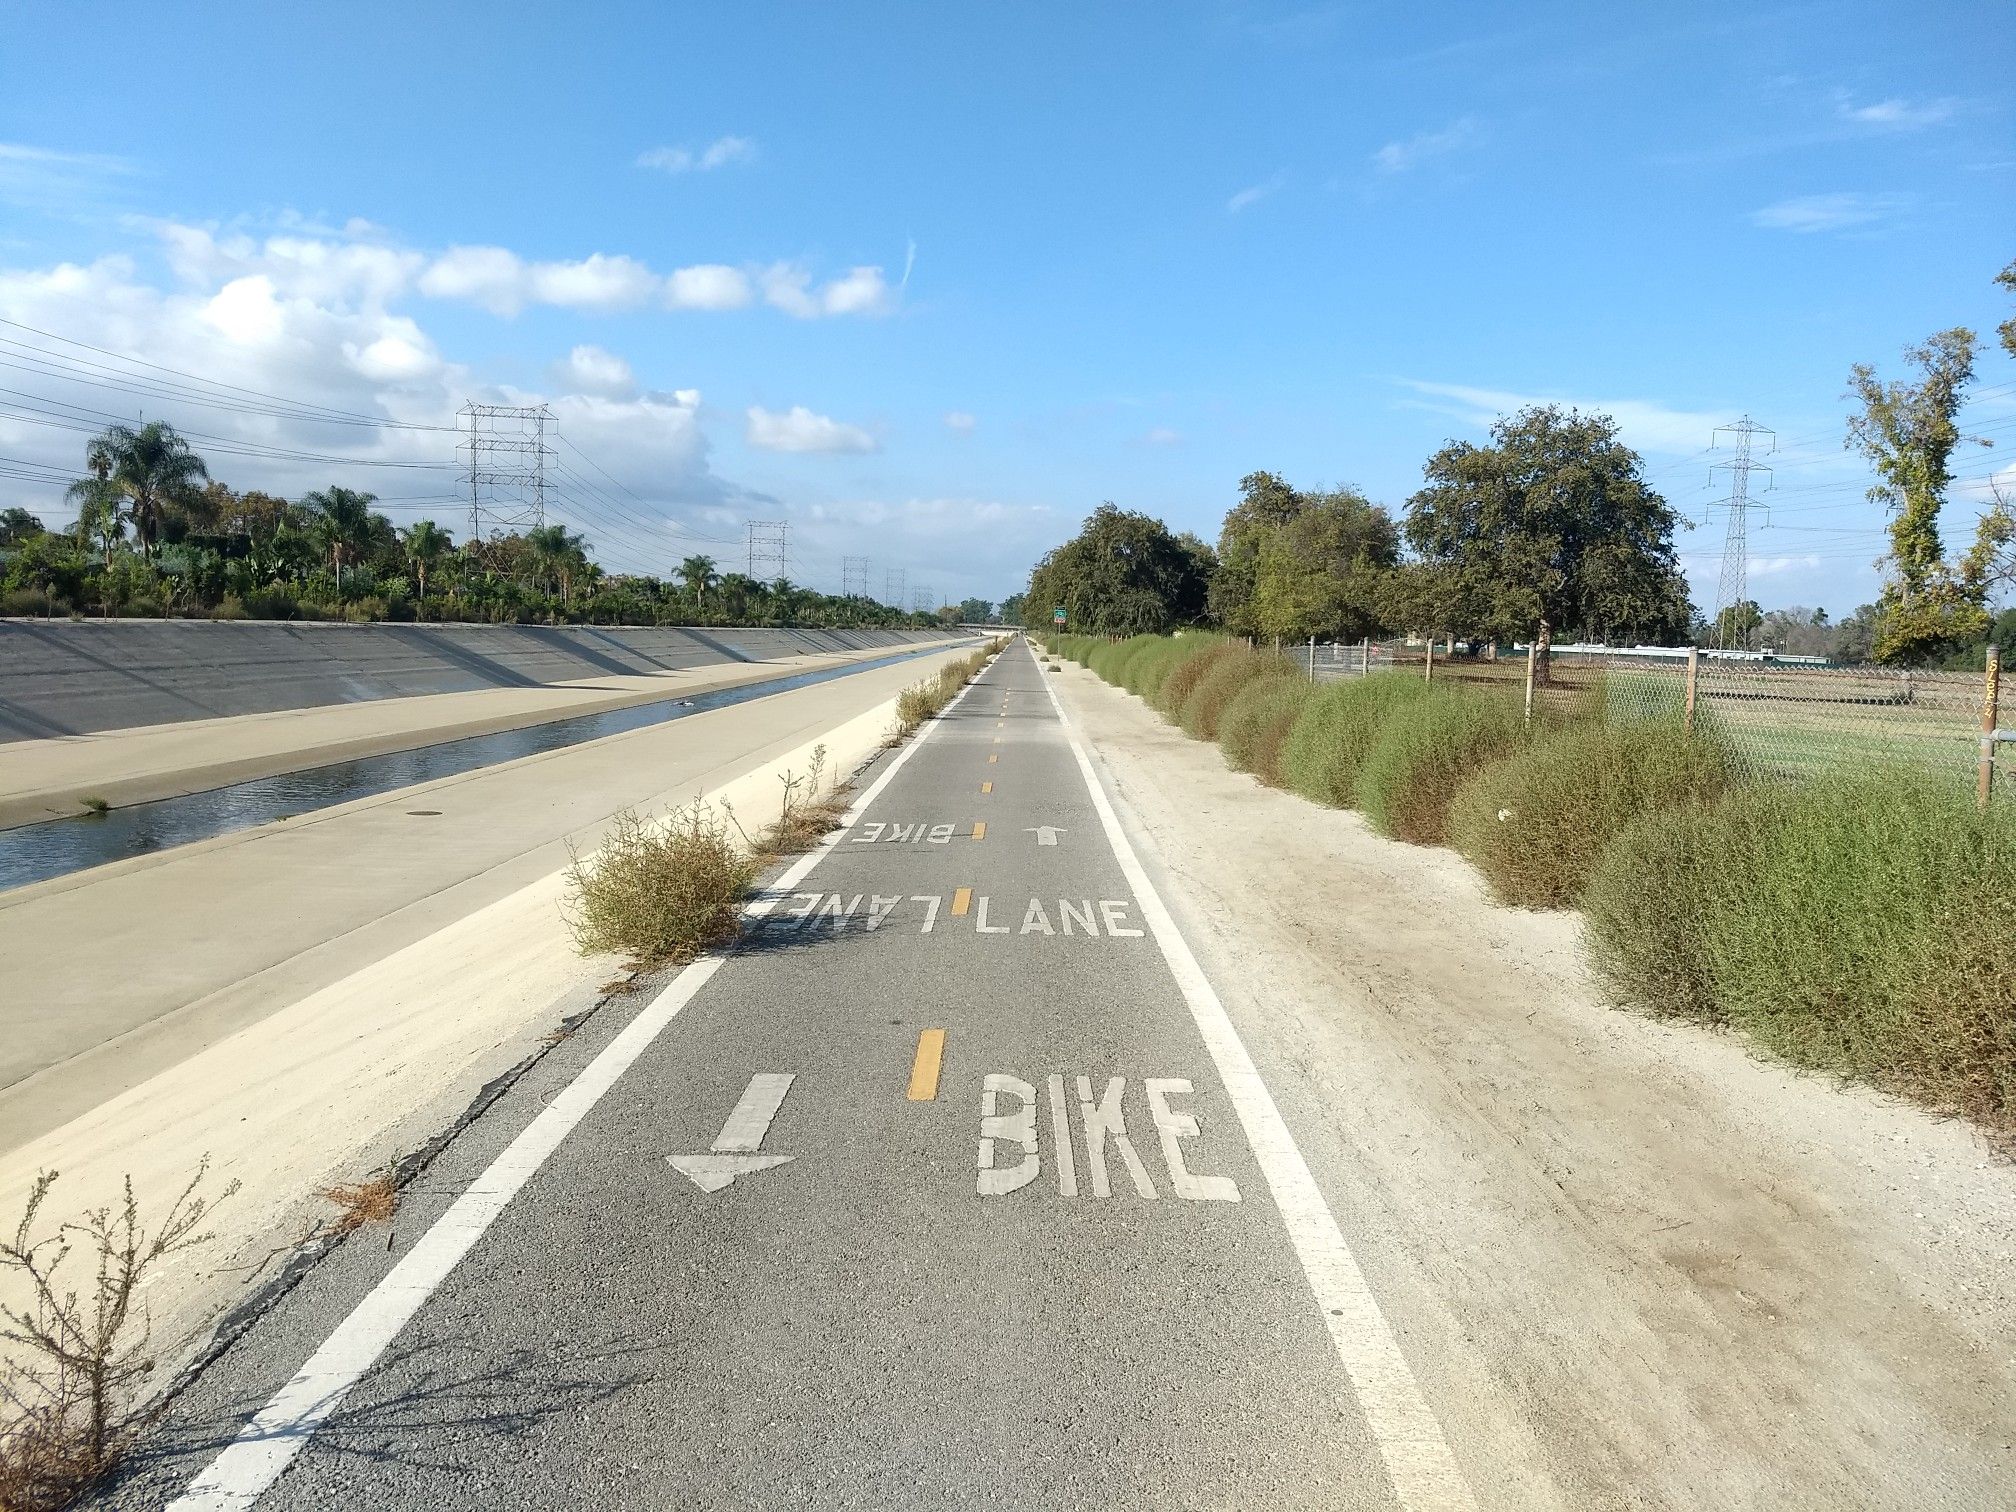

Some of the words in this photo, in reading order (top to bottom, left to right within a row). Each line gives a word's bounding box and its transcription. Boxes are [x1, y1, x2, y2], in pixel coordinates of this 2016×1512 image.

[851, 823, 956, 844] BIKE
[765, 893, 942, 934] LANE
[976, 896, 1145, 938] LANE
[977, 1073, 1242, 1202] BIKE
